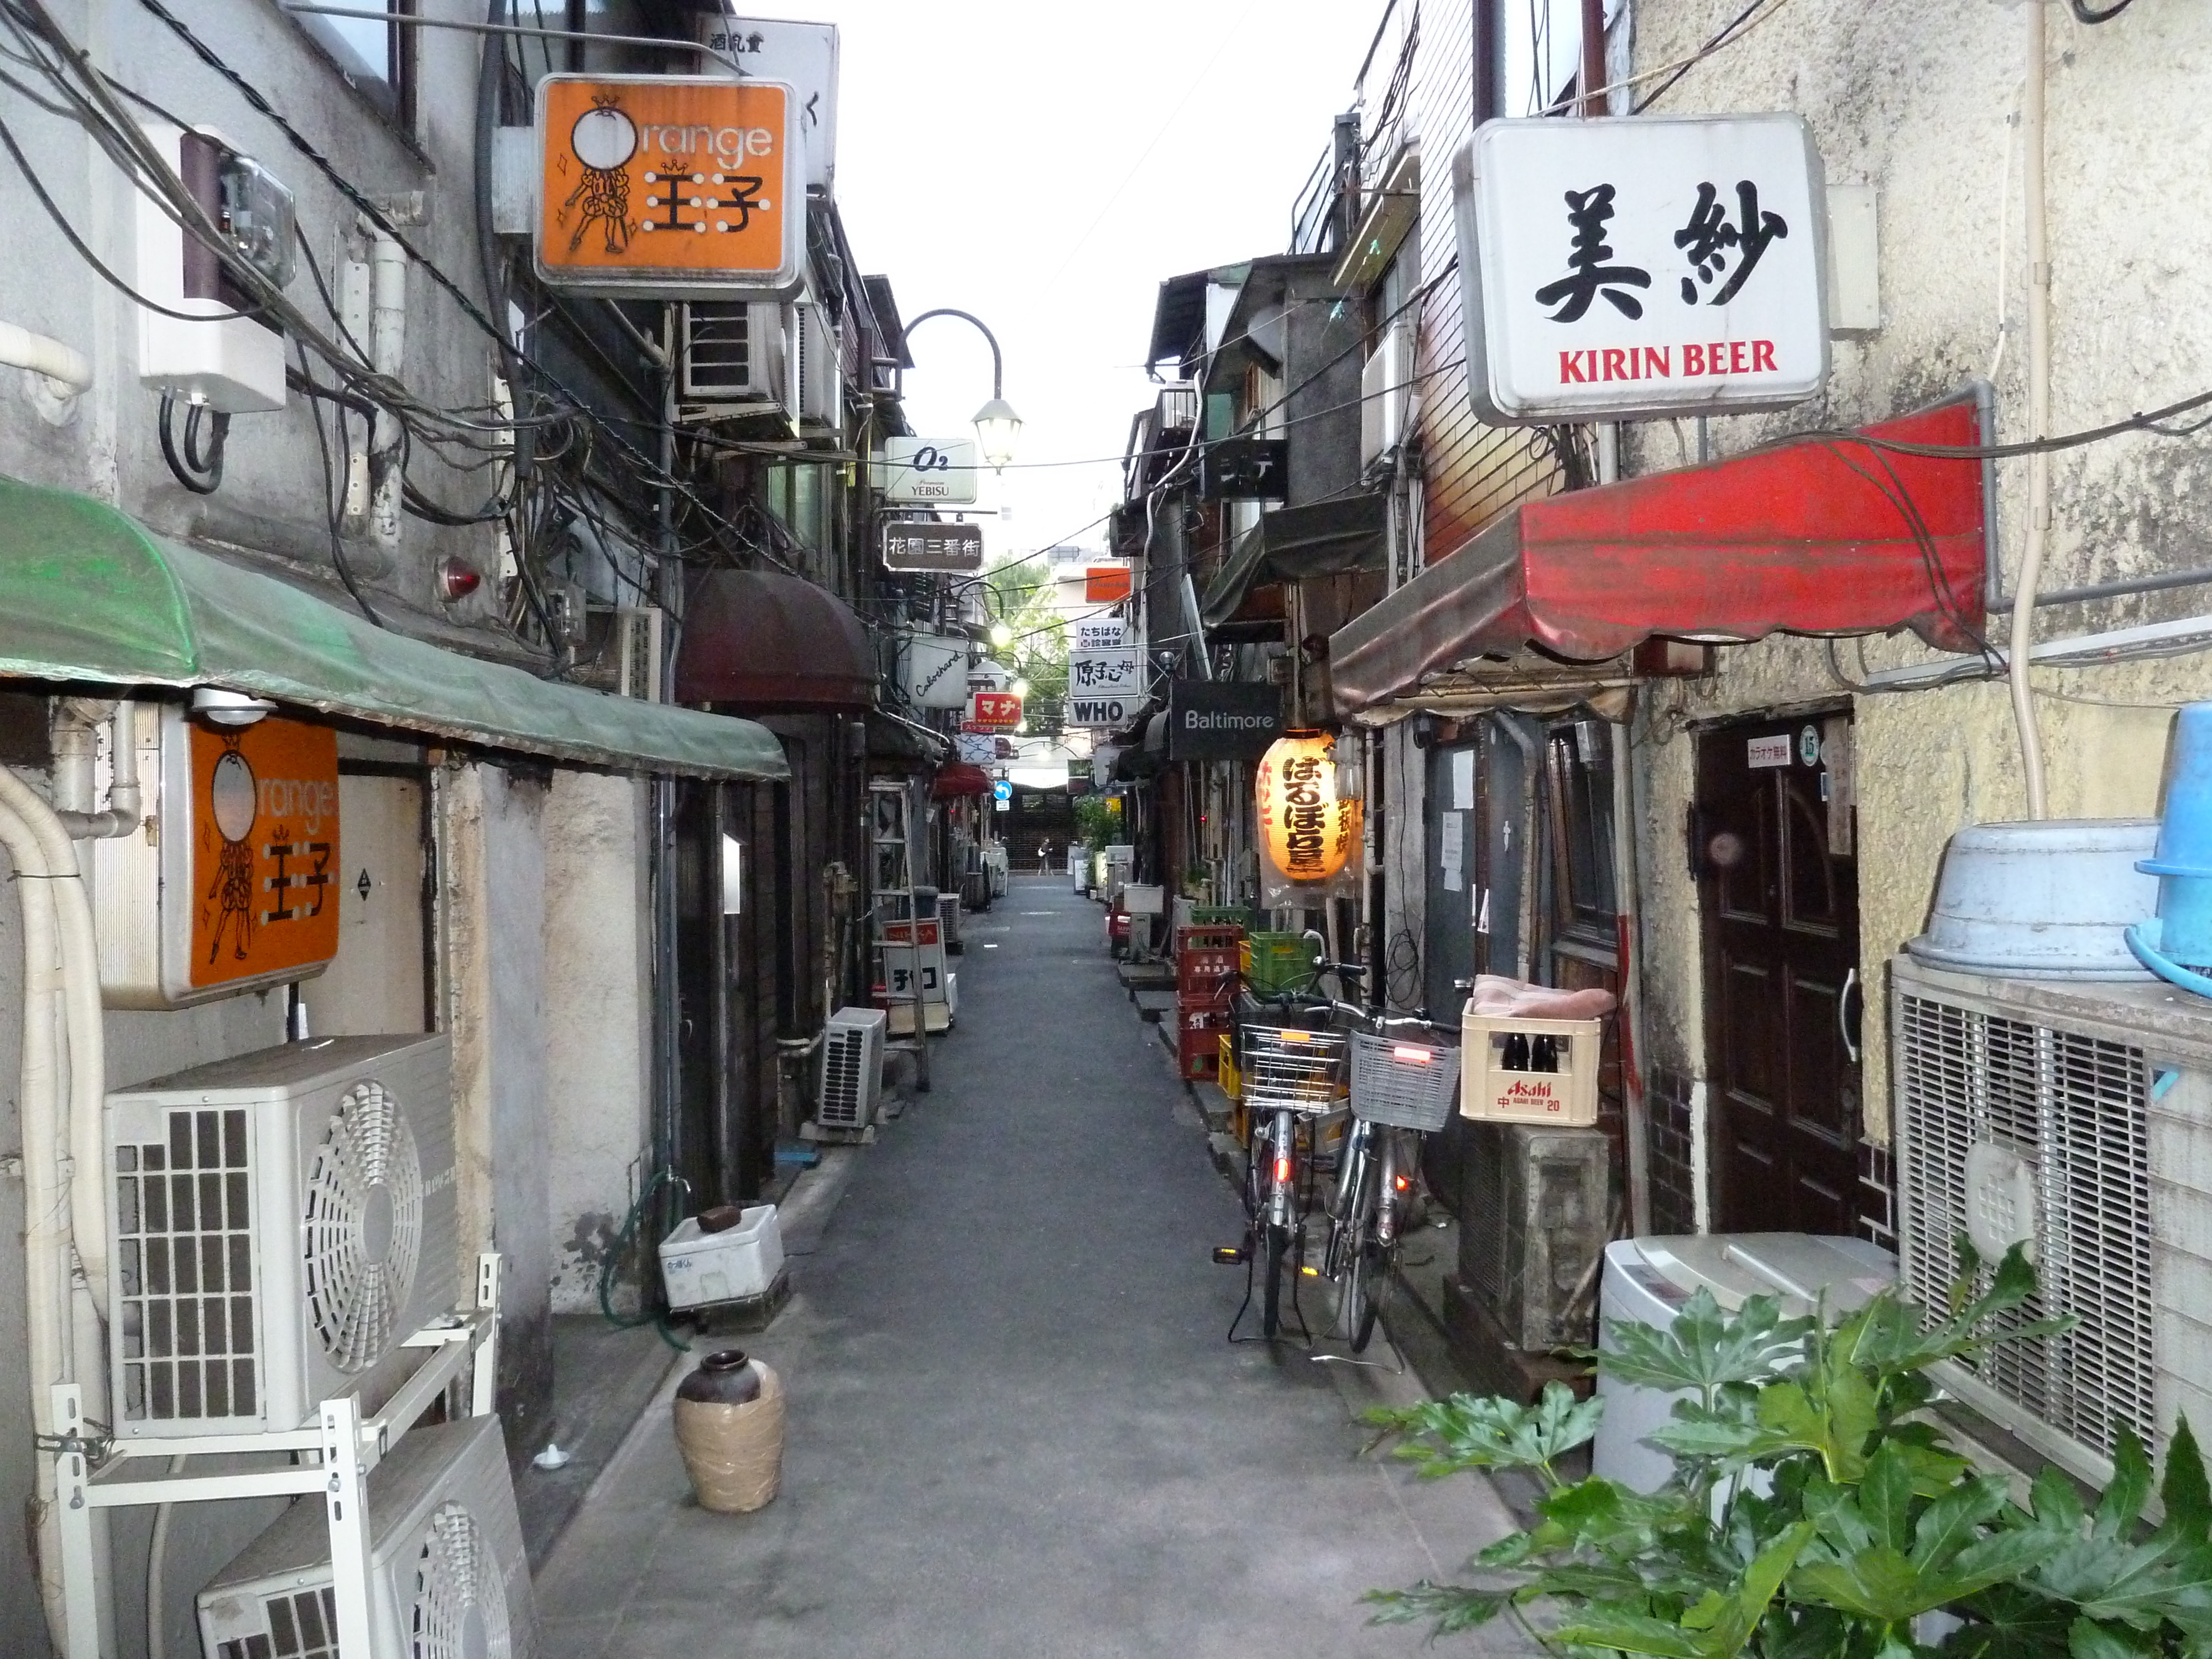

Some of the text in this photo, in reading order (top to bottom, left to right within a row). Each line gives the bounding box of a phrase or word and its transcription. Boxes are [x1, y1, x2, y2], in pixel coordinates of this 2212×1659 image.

[643, 171, 771, 233] 王子
[1535, 180, 1788, 323] 美紗
[1559, 340, 1778, 384] KIRIN BEER
[911, 486, 949, 496] YEBISU
[889, 536, 980, 557] 花園三番街
[1081, 627, 1121, 637] たちばな
[1074, 659, 1135, 687] 原子心母
[982, 700, 1015, 716] マナ
[1073, 701, 1124, 722] WHO
[1185, 709, 1274, 730] Baltimore
[261, 841, 335, 926] 王子
[1507, 1079, 1551, 1097] Asahi
[1498, 1097, 1510, 1109] 中
[1547, 1099, 1560, 1112] 20
